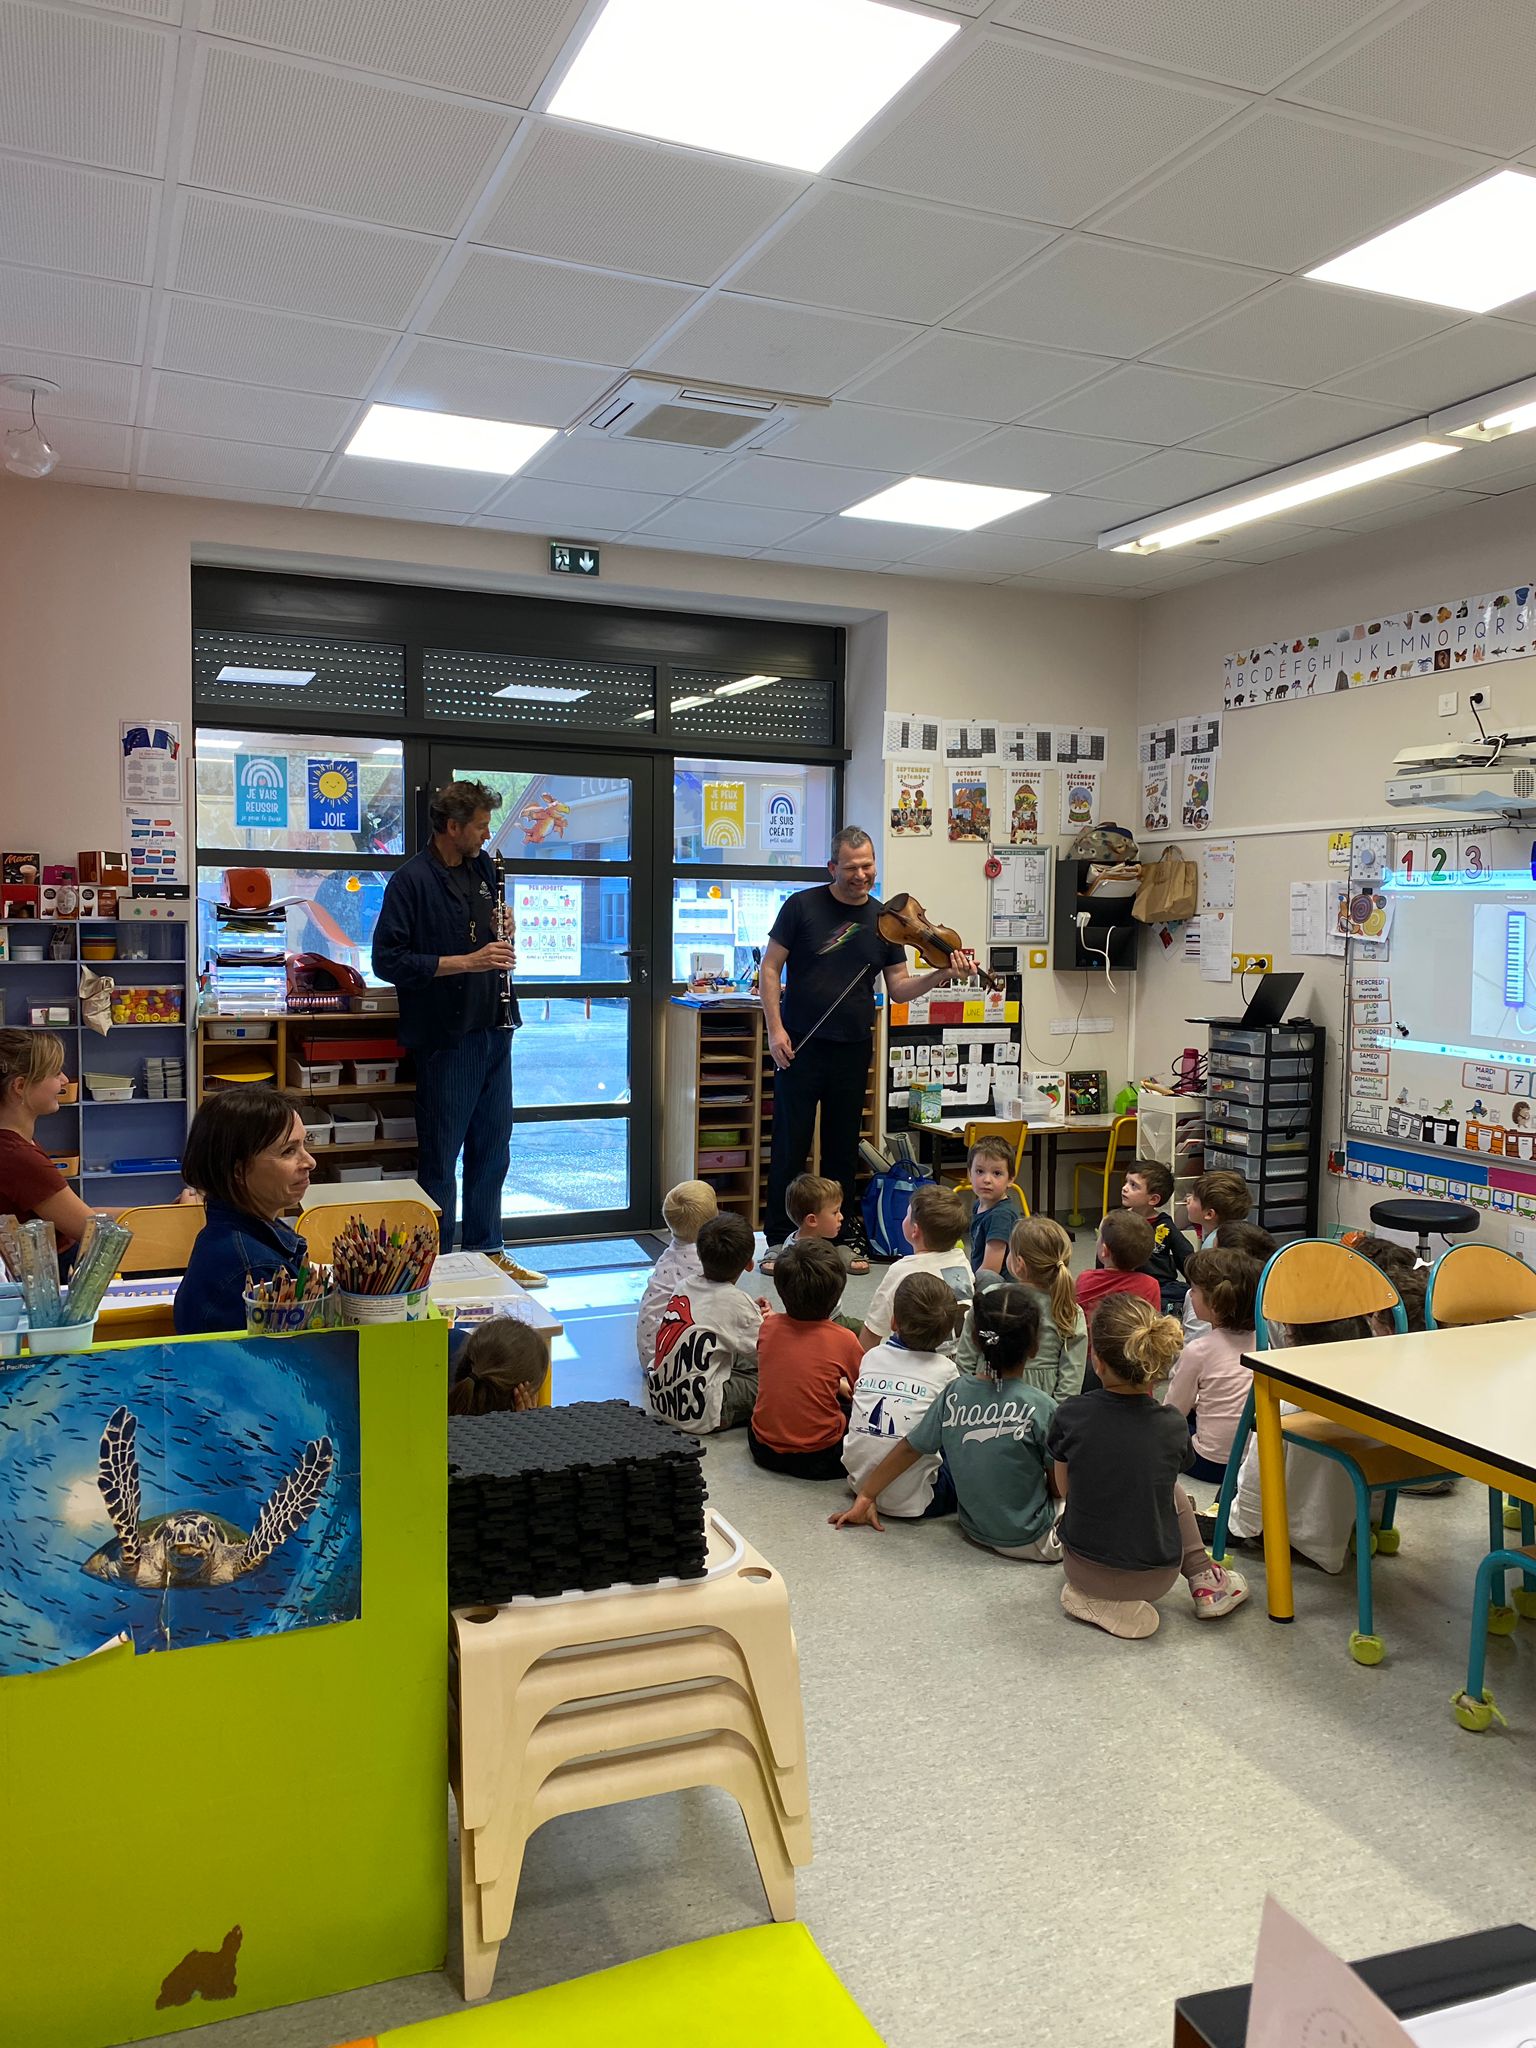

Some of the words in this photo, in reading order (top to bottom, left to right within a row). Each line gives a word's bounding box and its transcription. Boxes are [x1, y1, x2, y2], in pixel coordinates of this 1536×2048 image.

[1225, 677, 1231, 689] A
[1237, 673, 1244, 687] B
[1251, 670, 1258, 684] C
[1265, 667, 1272, 681] D
[1279, 660, 1286, 678] É
[1294, 660, 1301, 674] F
[1307, 657, 1316, 672] G
[1323, 656, 1331, 670] H
[1354, 648, 1362, 664] J
[1370, 644, 1378, 659] K
[1387, 641, 1394, 656] L
[1401, 637, 1414, 653] M
[1421, 634, 1430, 650] N
[1438, 629, 1448, 646] O
[1458, 625, 1466, 642] P
[1474, 621, 1487, 639] Q
[1496, 617, 1504, 634] R
[1515, 614, 1525, 631] S
[246, 789, 256, 800] JE
[259, 790, 278, 801] VAIS
[245, 801, 279, 814] REUSSIR
[710, 801, 718, 811] LE
[720, 802, 737, 811] FAIRE
[321, 812, 346, 827] JOIE
[770, 816, 777, 825] JE
[779, 816, 794, 825] SUIS
[769, 825, 794, 836] CRÉATIF
[1431, 829, 1452, 838] DEUX
[1401, 850, 1414, 881] 1
[1431, 848, 1447, 881] 2
[1465, 845, 1483, 879] 3
[1354, 1076, 1383, 1084] DIMANCHE
[1475, 1066, 1496, 1075] MARDI
[1514, 1075, 1524, 1089] 7
[1476, 1082, 1493, 1090] mardi
[1372, 1168, 1377, 1176] 2
[1393, 1172, 1398, 1180] 3
[1412, 1176, 1417, 1184] 4
[1434, 1181, 1439, 1190] 5
[1455, 1184, 1460, 1193] 6
[1478, 1189, 1483, 1197] 7
[1500, 1193, 1505, 1202] 8
[1525, 1199, 1530, 1208] 9
[247, 1307, 304, 1325] OTTO
[7, 1363, 36, 1371] Pacifique
[857, 1377, 893, 1390] SAILOR
[895, 1381, 927, 1397] CLUB
[942, 1393, 1036, 1440] Snoopy
